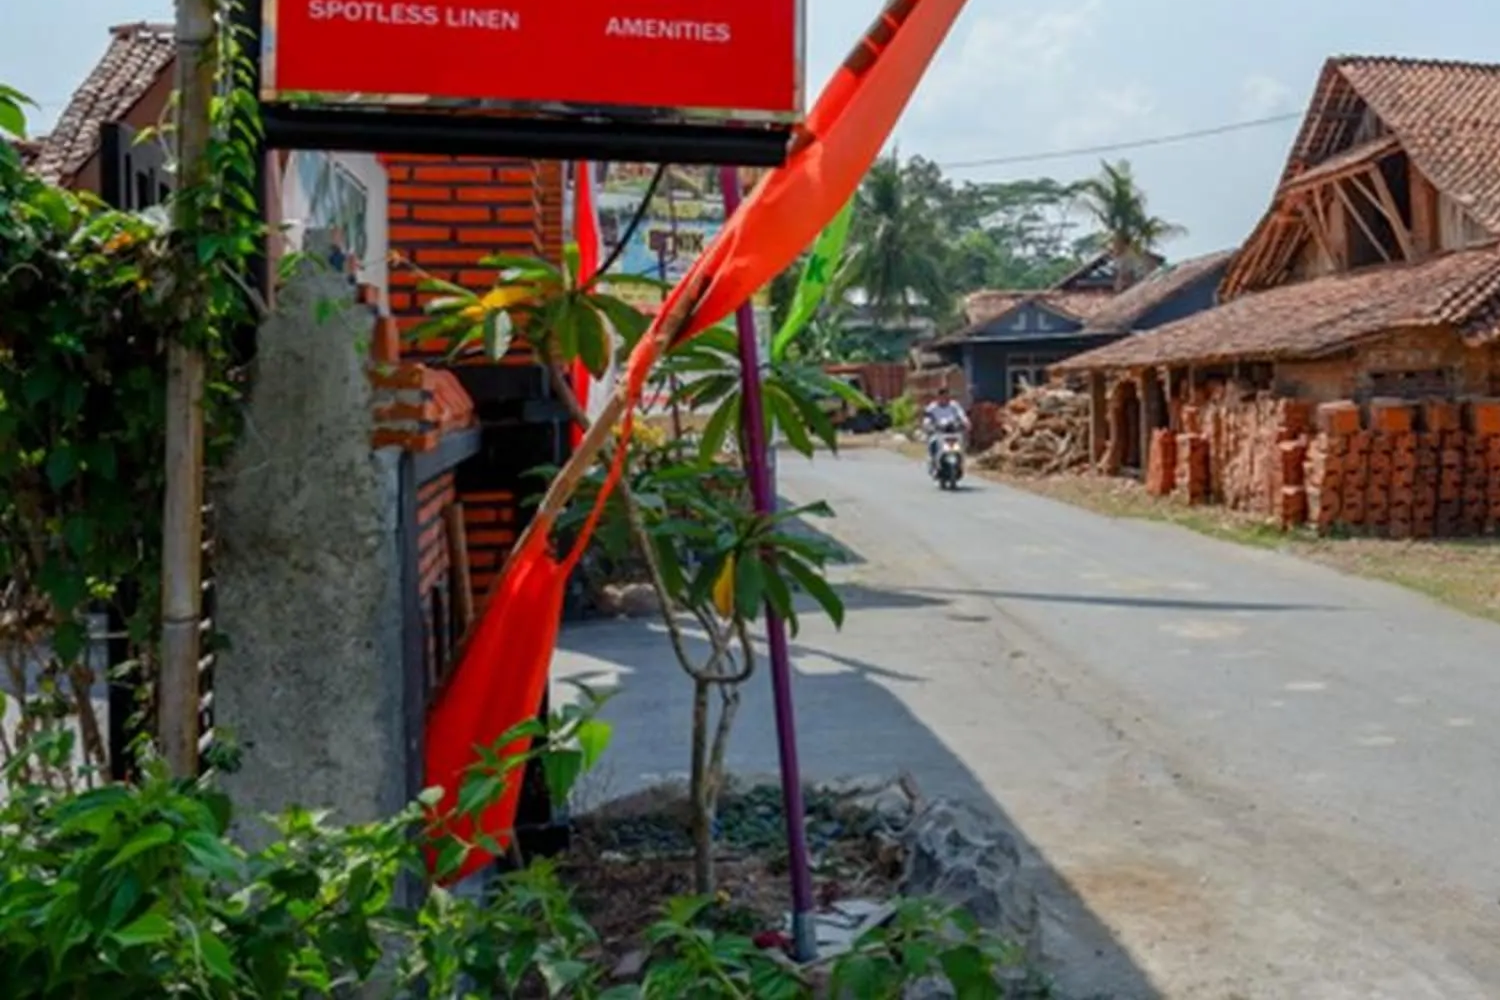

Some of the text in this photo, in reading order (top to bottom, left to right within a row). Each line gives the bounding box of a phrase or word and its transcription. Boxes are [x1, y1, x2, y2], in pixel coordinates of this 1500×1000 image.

[308, 0, 520, 30] SPOTLESS LINEN
[605, 16, 731, 42] AMENITIES
